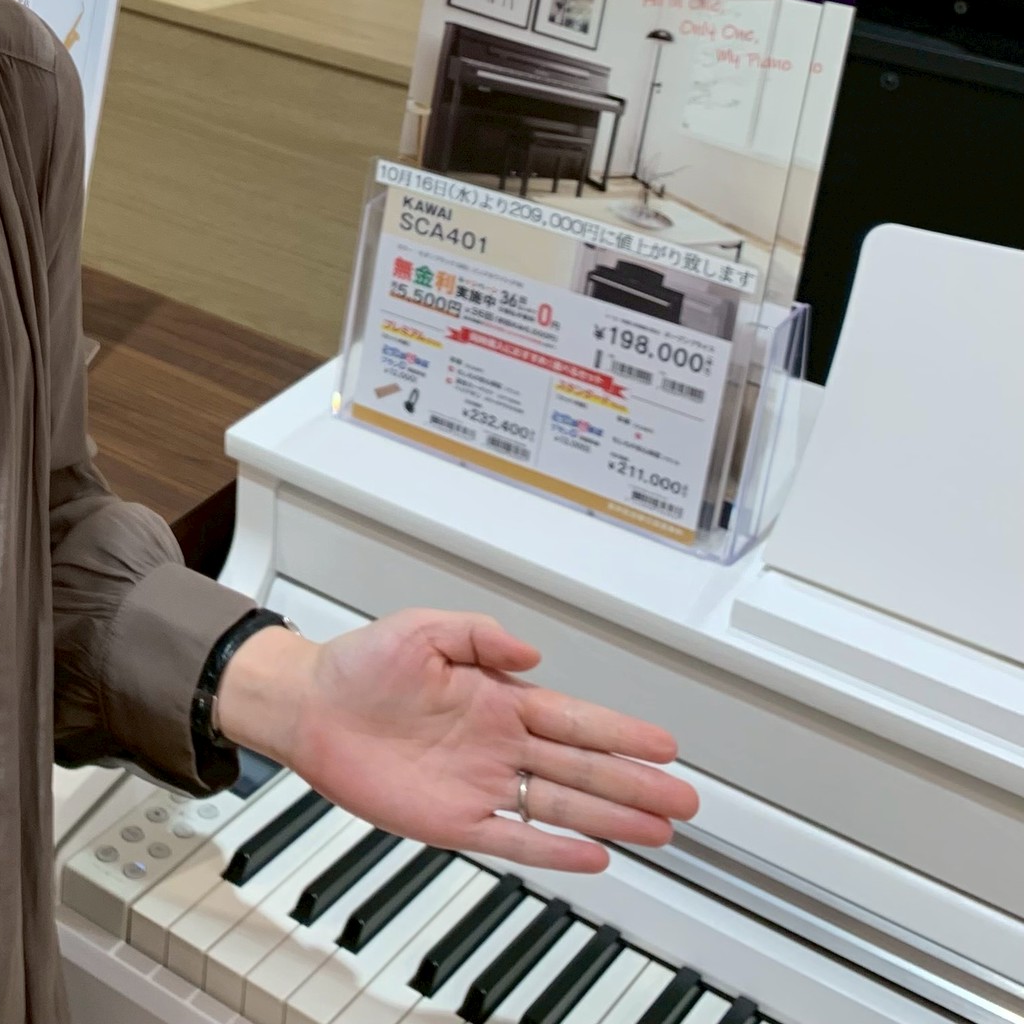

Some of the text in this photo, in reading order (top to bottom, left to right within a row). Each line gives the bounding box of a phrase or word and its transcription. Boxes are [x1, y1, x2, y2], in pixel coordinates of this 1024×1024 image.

[679, 19, 716, 40] Only
[716, 49, 792, 72] My Piano
[403, 195, 453, 221] KAWAI
[399, 212, 489, 254] SCA401
[392, 255, 457, 296] 無金利
